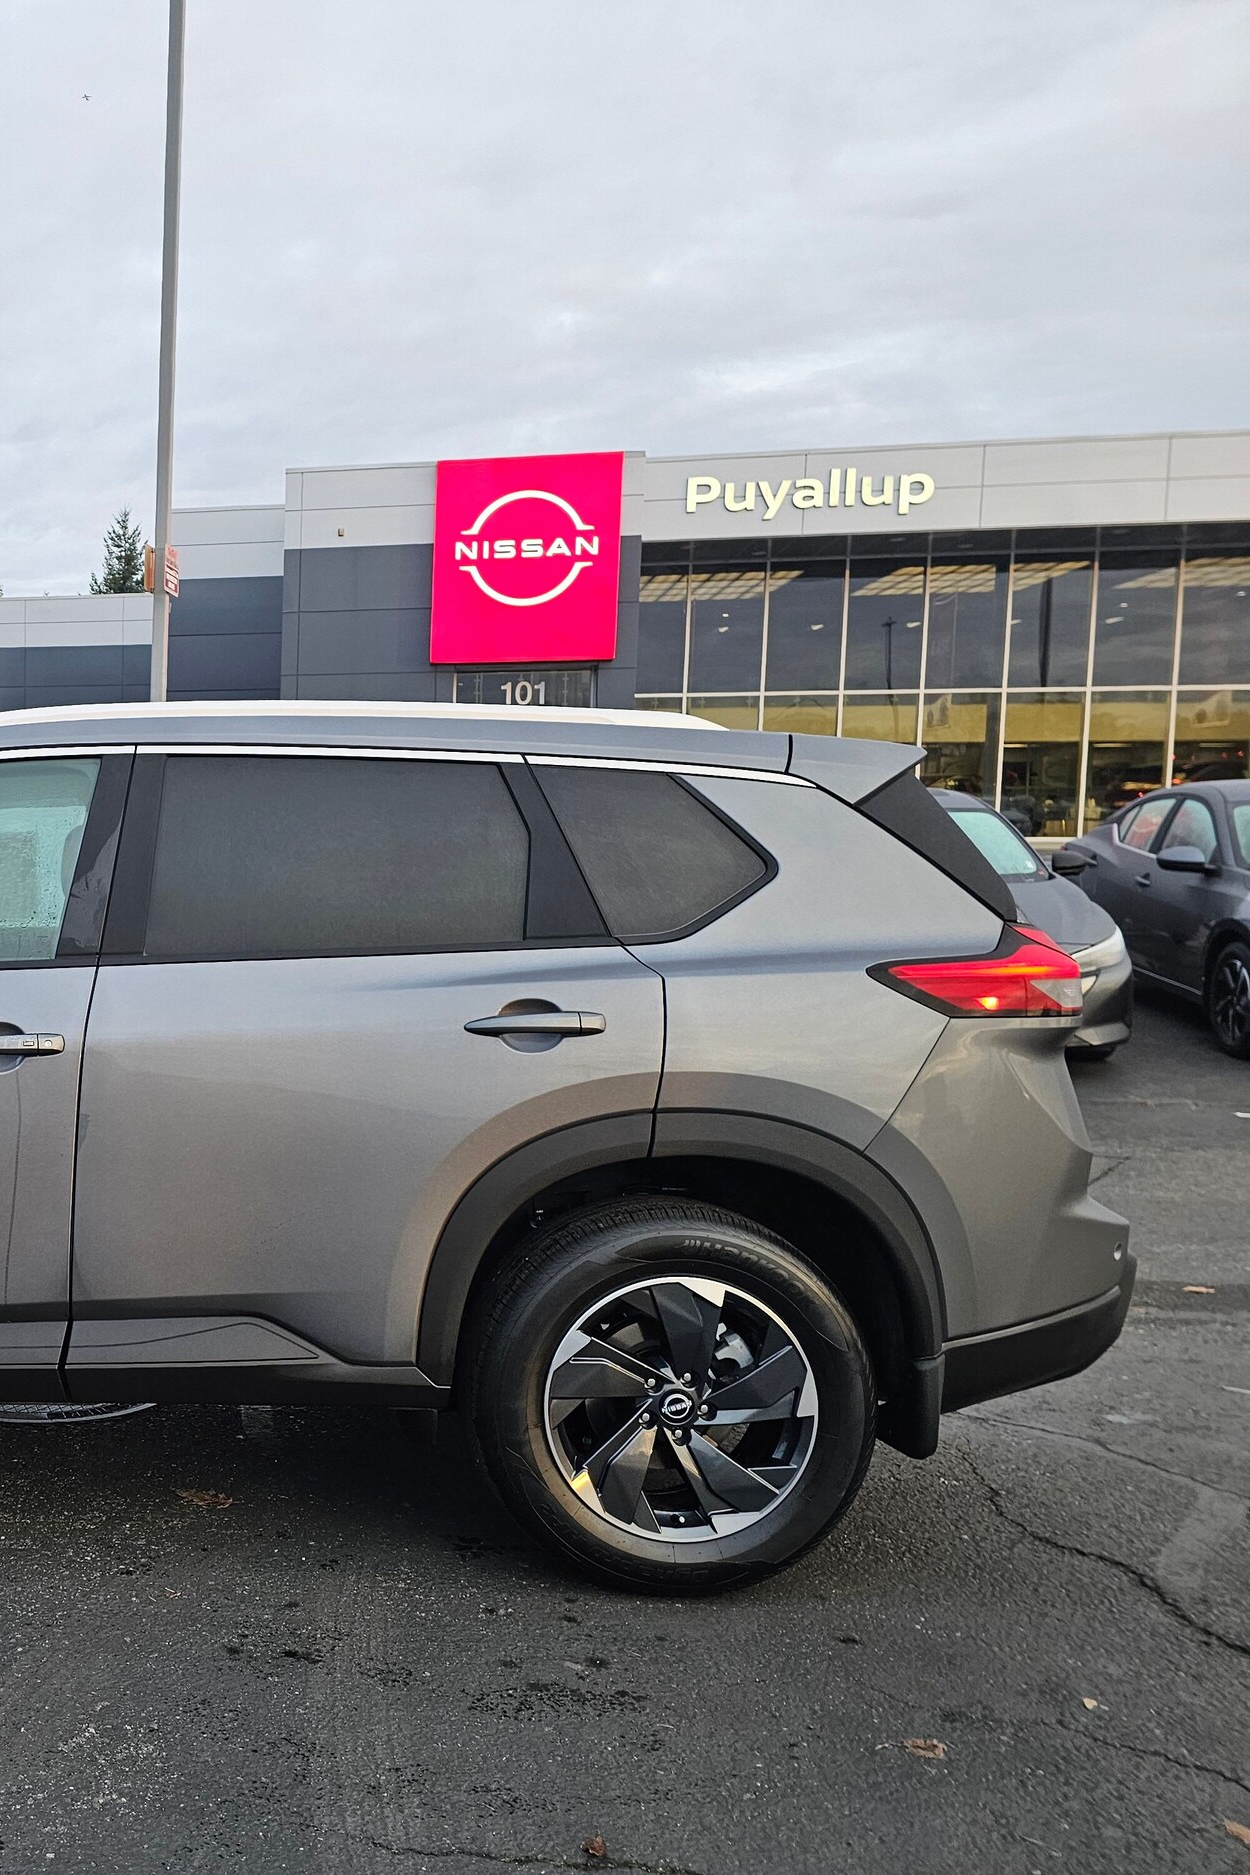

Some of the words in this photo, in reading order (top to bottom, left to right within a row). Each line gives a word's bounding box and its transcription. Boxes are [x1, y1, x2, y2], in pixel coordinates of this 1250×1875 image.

[686, 467, 936, 521] Puyallup
[455, 535, 600, 561] NISSAN
[501, 681, 546, 705] 101
